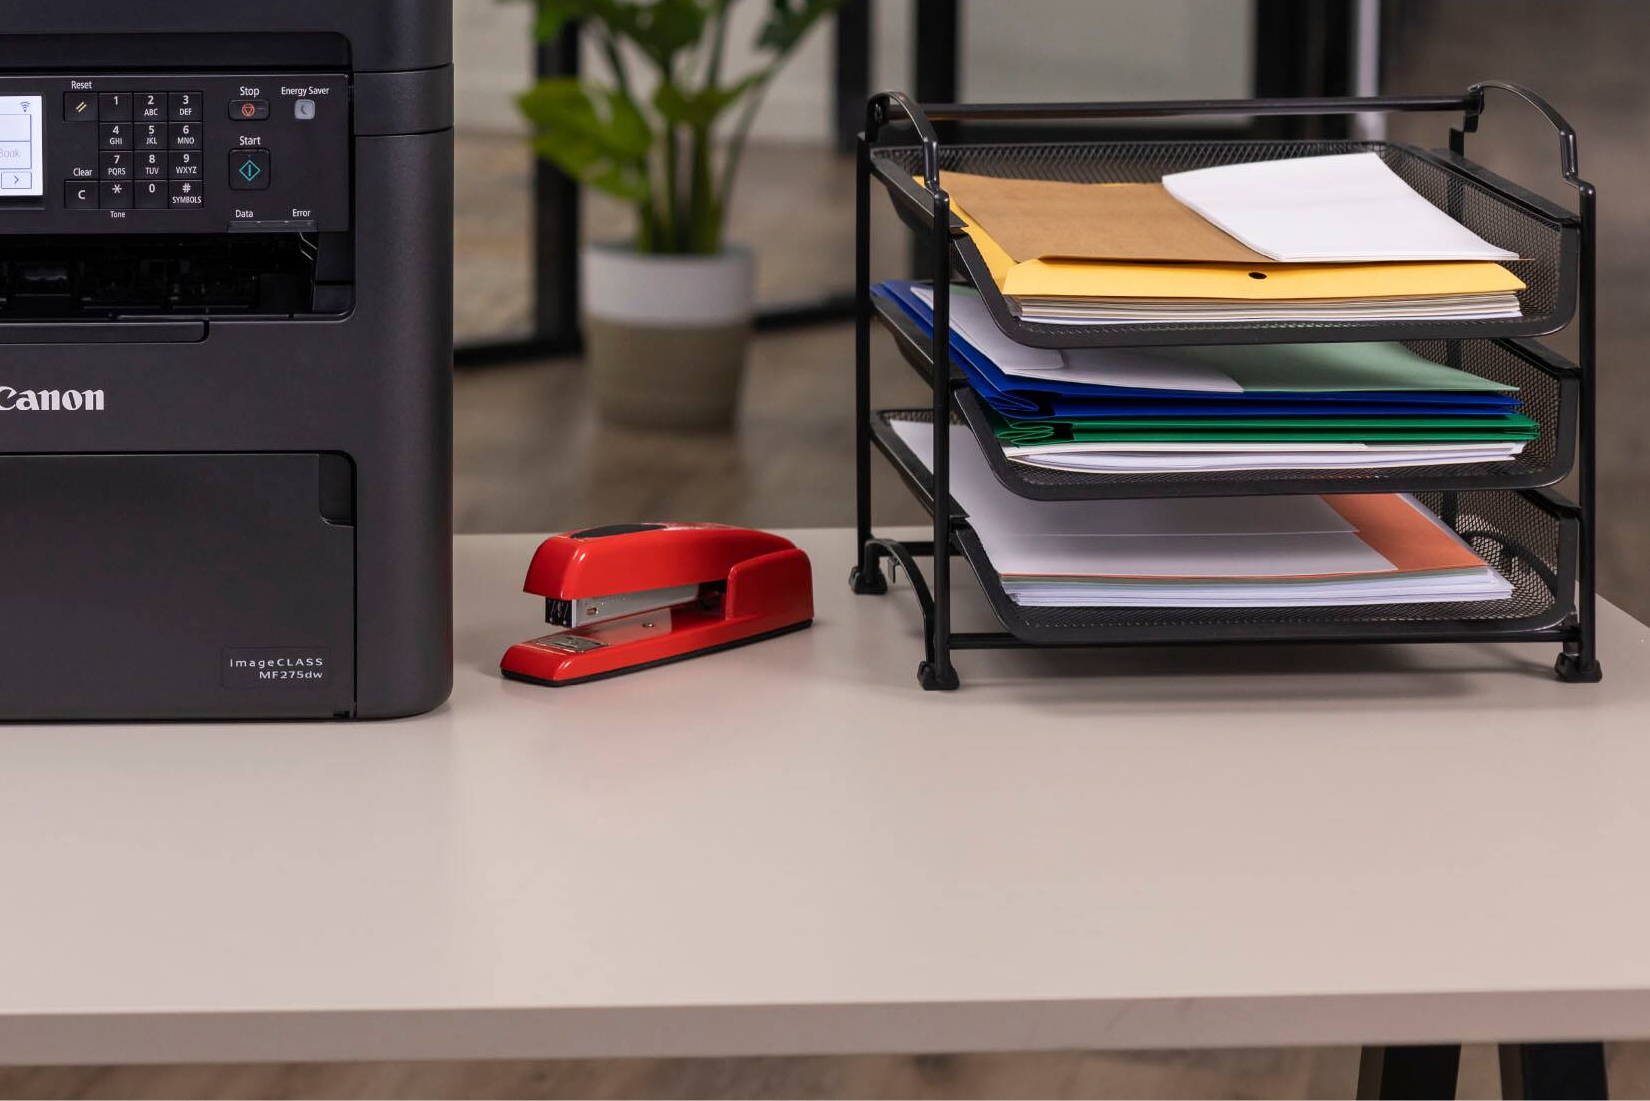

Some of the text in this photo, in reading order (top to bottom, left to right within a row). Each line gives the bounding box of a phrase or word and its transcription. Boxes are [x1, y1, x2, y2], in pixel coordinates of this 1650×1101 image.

[71, 81, 92, 89] Reset
[240, 86, 259, 97] Stop
[281, 86, 329, 96] Energy Saver
[114, 96, 118, 105] 1
[148, 95, 154, 105] 2
[183, 95, 189, 104] 3
[113, 126, 119, 134] 4
[148, 125, 154, 134] 5
[183, 125, 189, 134] 6
[239, 136, 261, 145] Start
[114, 155, 120, 163] 7
[149, 155, 155, 163] 8
[184, 154, 189, 163] 9
[73, 168, 92, 176] Clear
[149, 184, 155, 193] 0
[78, 190, 86, 199] C
[236, 210, 253, 218] Data
[259, 671, 322, 679] MF275dw
